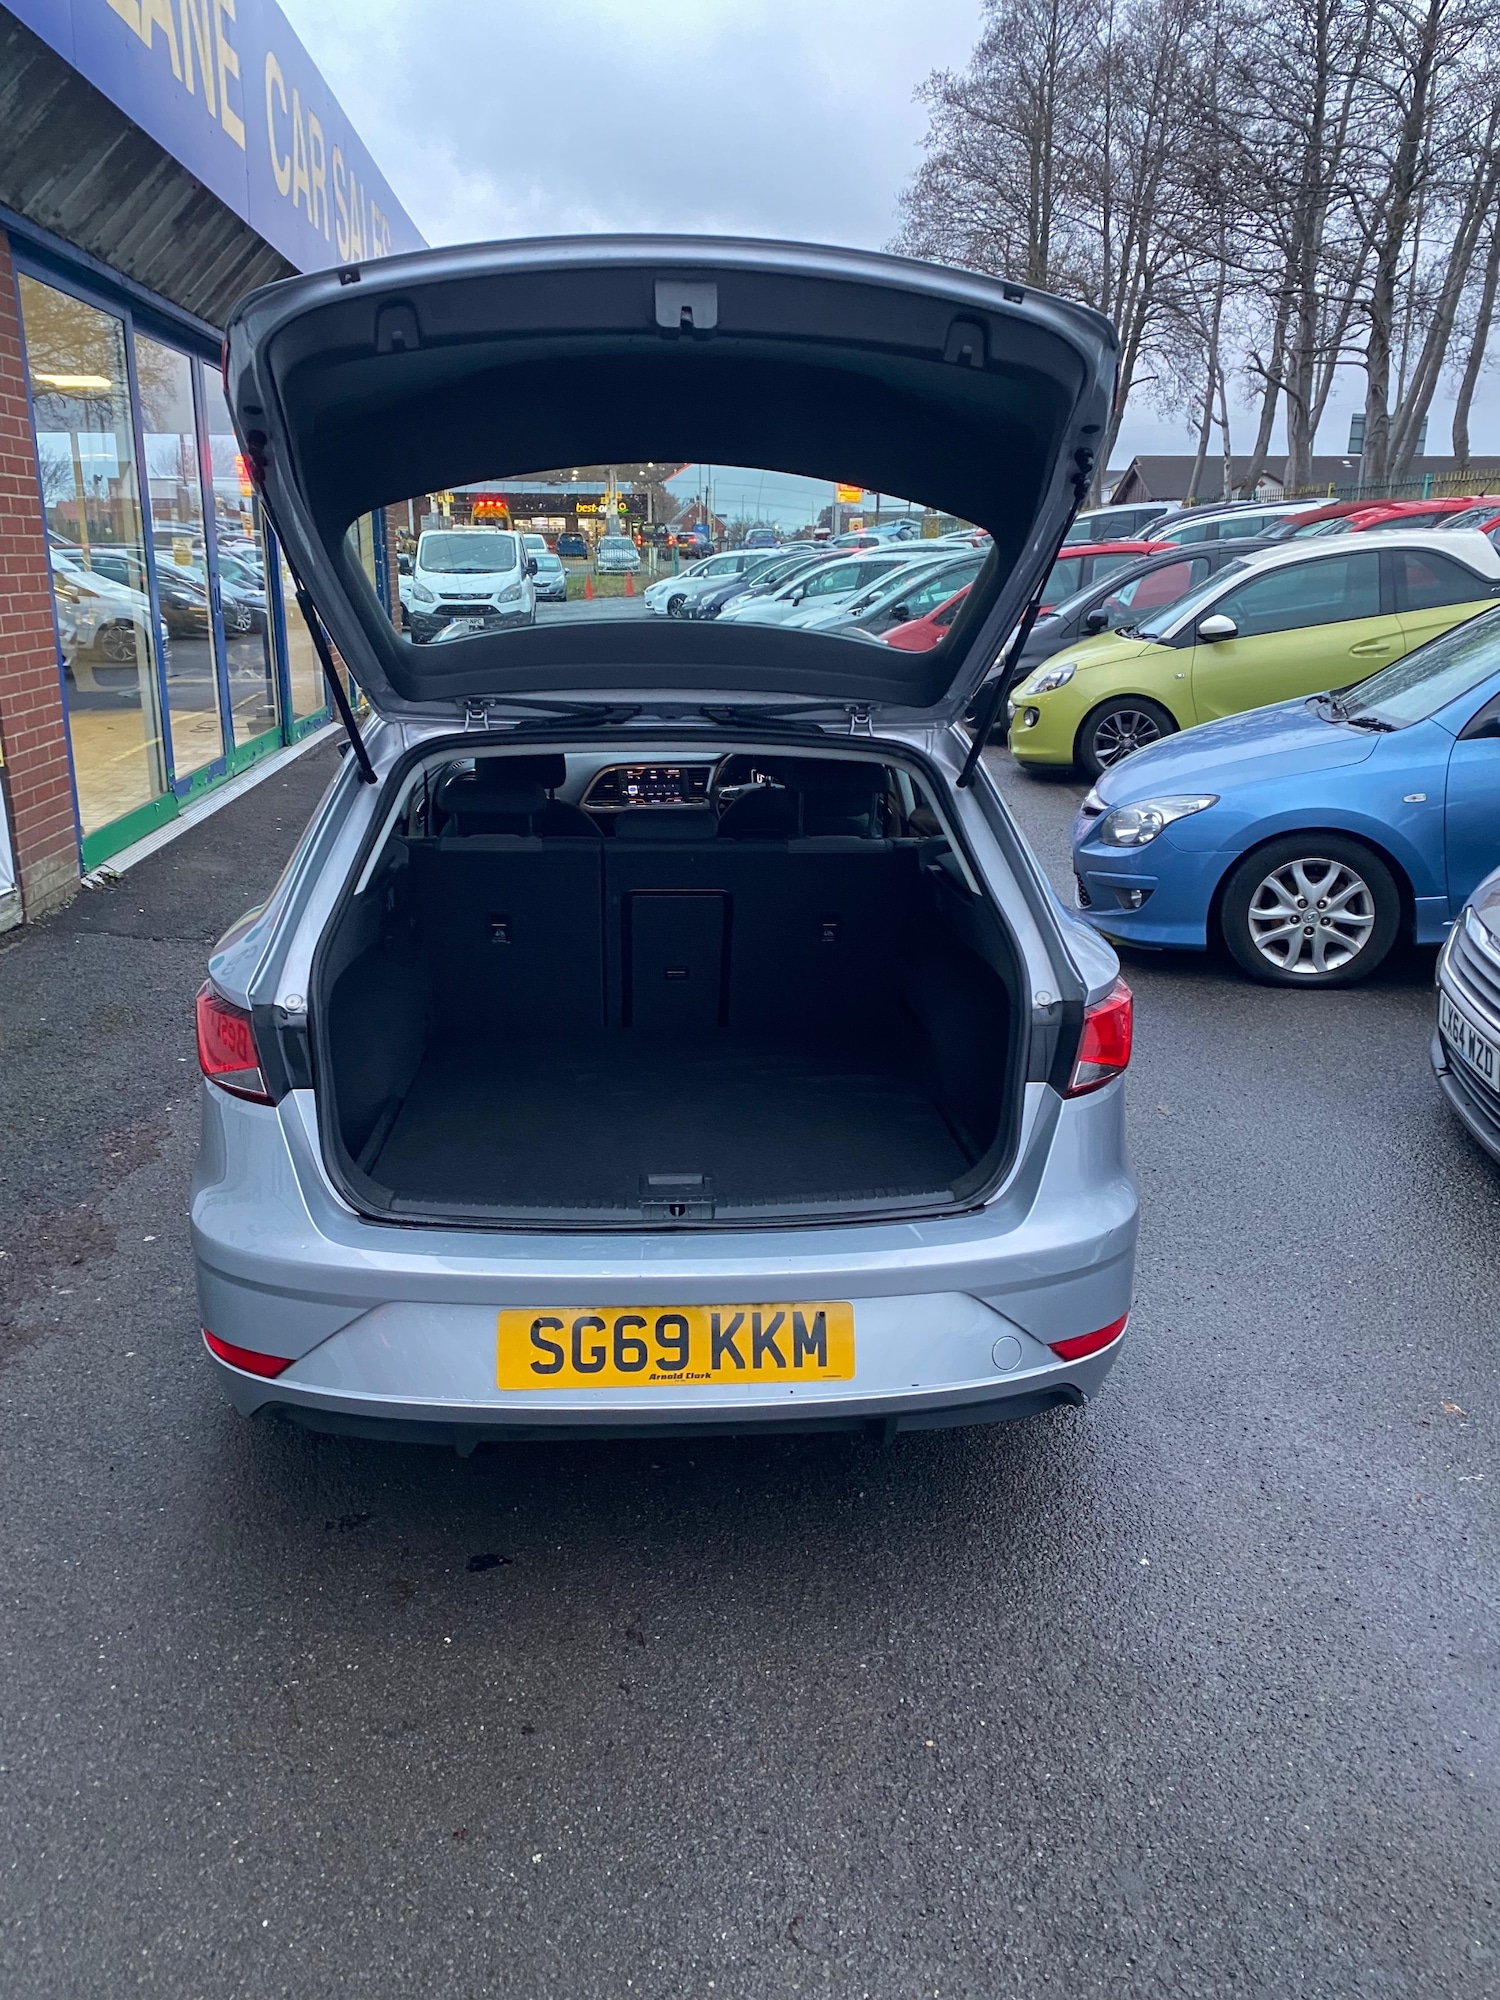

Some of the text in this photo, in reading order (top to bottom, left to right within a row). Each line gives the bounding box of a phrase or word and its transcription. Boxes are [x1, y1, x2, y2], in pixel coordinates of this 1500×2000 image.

[265, 51, 330, 242] CAR
[576, 502, 607, 513] best-o
[1442, 997, 1493, 1079] LX64 MZD
[530, 1311, 828, 1375] SG69 KKM
[648, 1372, 712, 1381] Arnold Clark
